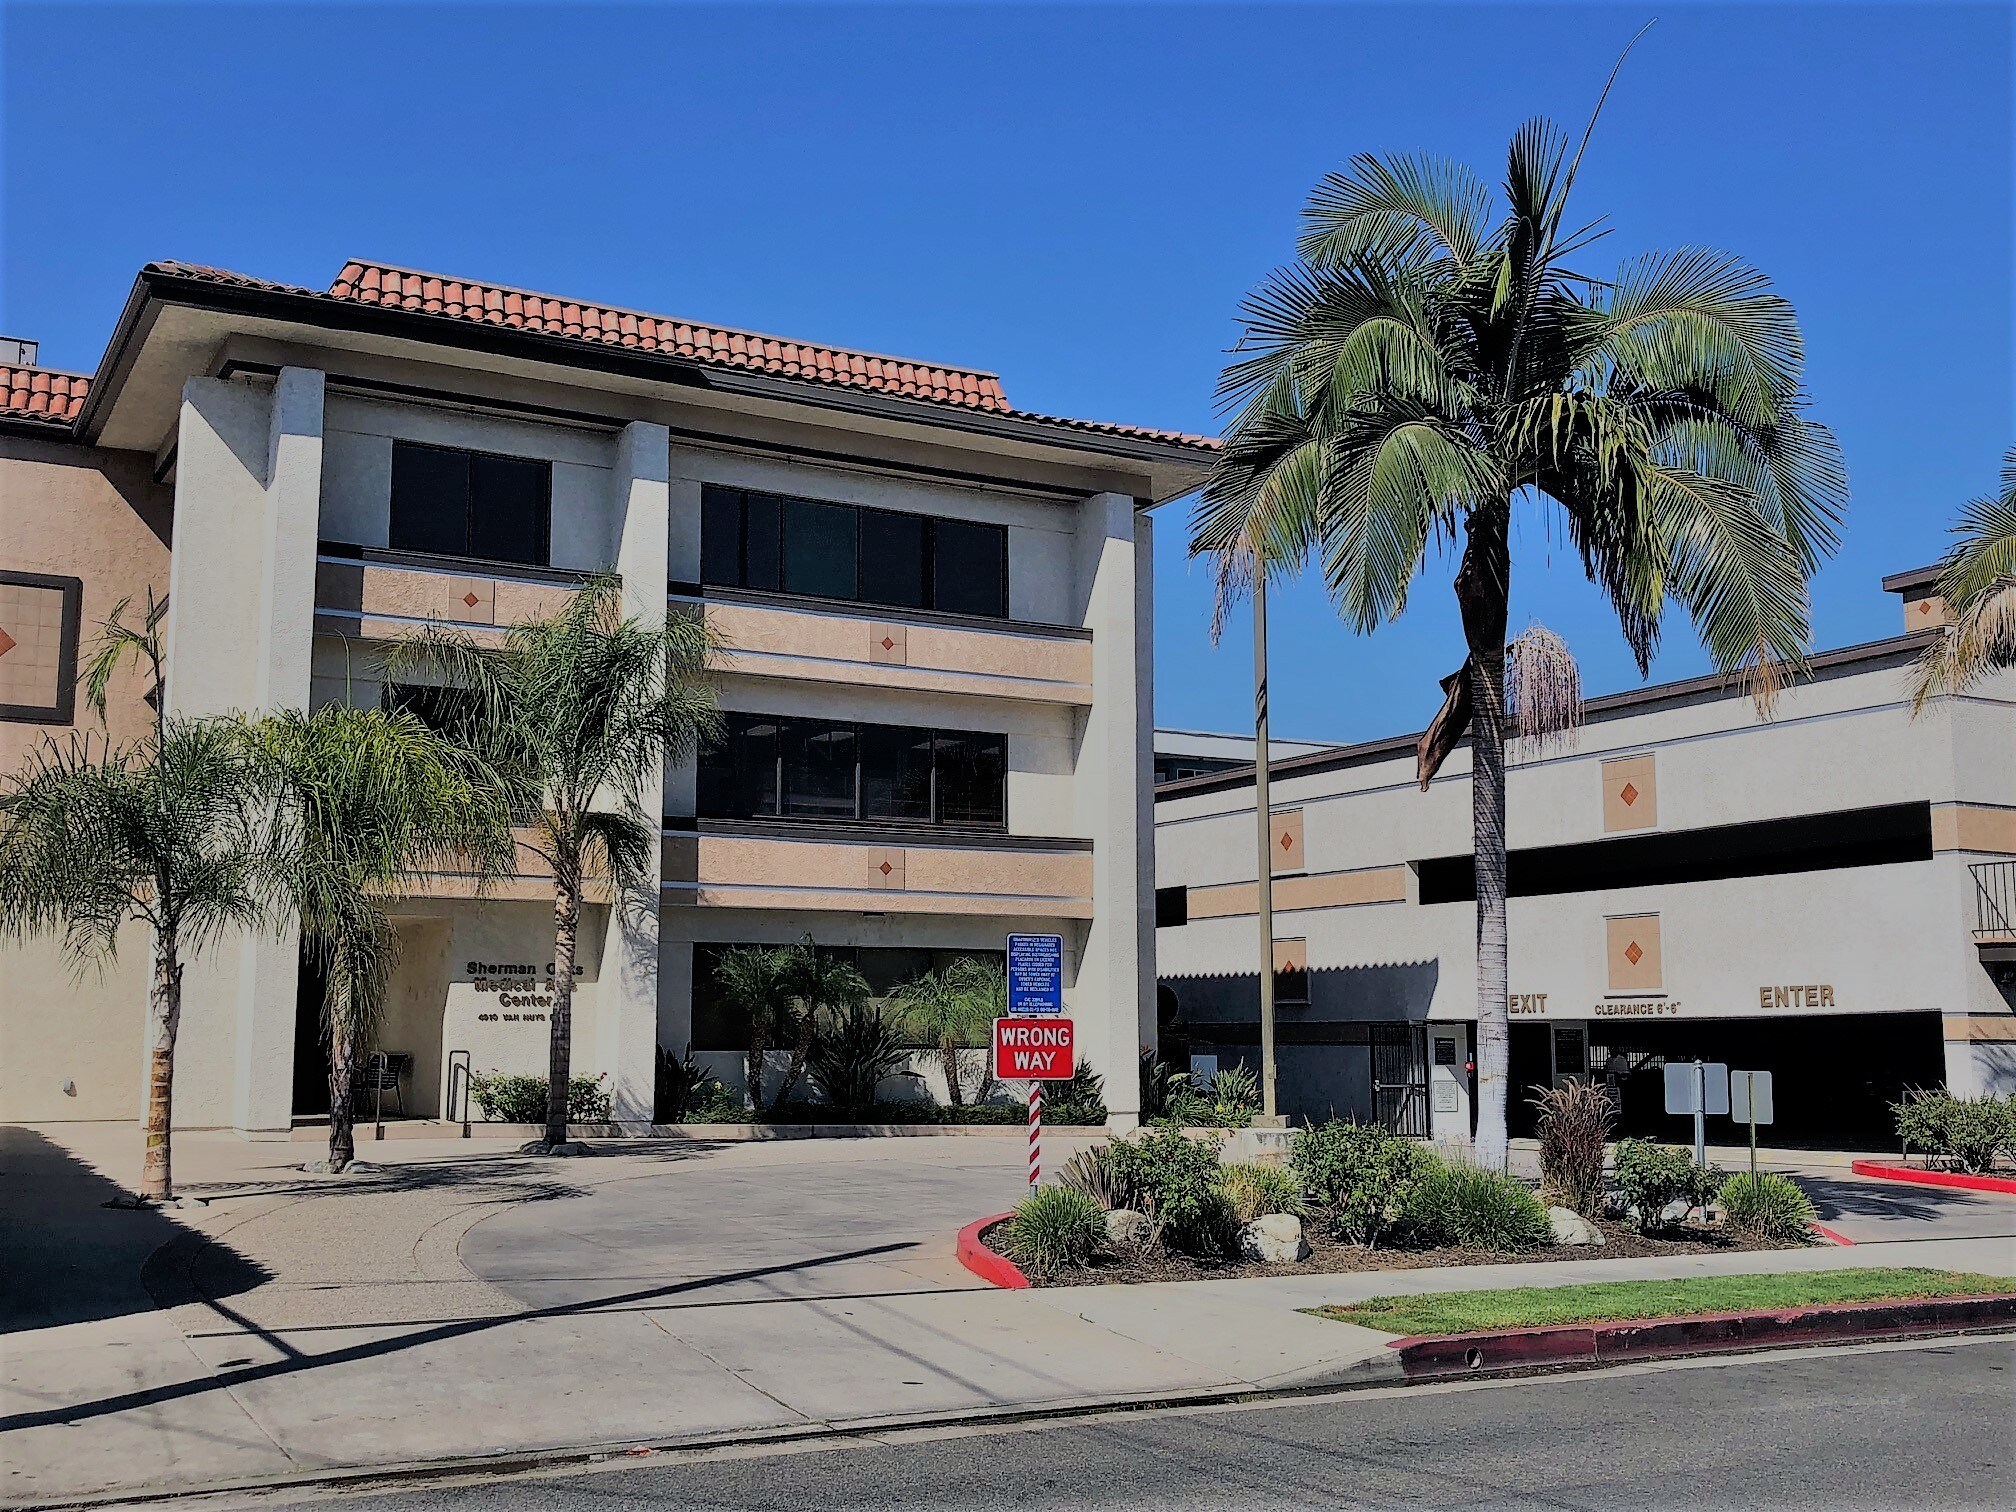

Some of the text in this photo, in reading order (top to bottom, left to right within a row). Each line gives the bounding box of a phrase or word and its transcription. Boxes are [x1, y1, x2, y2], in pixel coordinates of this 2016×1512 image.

[466, 961, 537, 975] Sherman
[474, 976, 536, 992] Medical
[499, 992, 553, 1007] Center
[1509, 993, 1548, 1014] EXIT
[1760, 984, 1835, 1008] ENTER
[1594, 1003, 1654, 1016] CLEARANCE
[1000, 1027, 1070, 1047] WRONG
[1014, 1051, 1057, 1071] WAY
